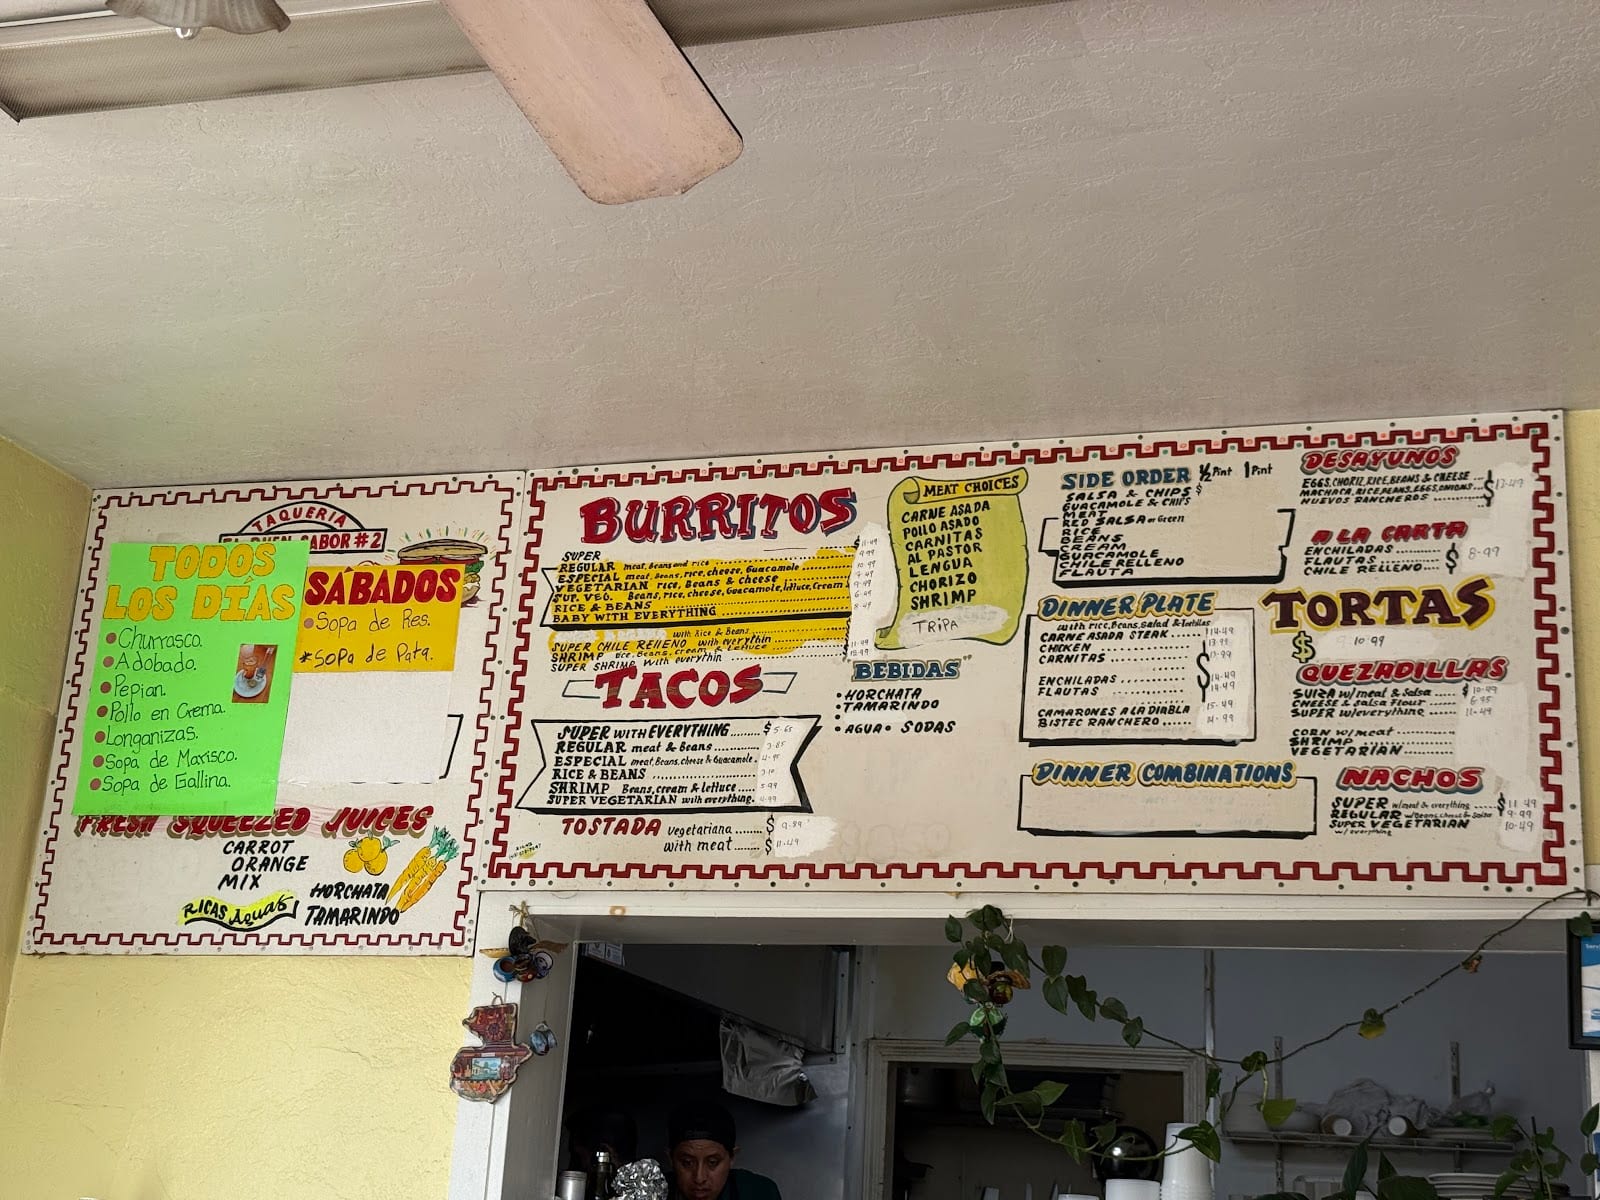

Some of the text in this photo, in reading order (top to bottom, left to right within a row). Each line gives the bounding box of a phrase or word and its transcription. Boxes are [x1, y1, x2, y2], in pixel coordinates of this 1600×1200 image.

[1301, 446, 1459, 474] DESAYUNOS
[922, 475, 1020, 498] MEAT CHOICES
[1061, 471, 1115, 490] SIDE
[1121, 467, 1192, 487] ORDER
[1066, 486, 1192, 502] SALSA CHIPS
[901, 500, 991, 524] CARNE ASADA
[1062, 499, 1145, 512] GUACAMOLE
[252, 506, 347, 532] TAQUERIA
[579, 487, 857, 543] BURRITOS
[1062, 510, 1108, 519] MEAT
[1062, 515, 1146, 528] RED SALSA
[940, 516, 980, 532] ASADO
[1062, 527, 1101, 537] RICE
[301, 532, 350, 550] ABOR
[905, 527, 984, 552] CARNITAS
[1060, 534, 1124, 544] BEANS
[1311, 521, 1469, 545] A LA CARTA
[907, 542, 983, 566] AL PASTOR
[1059, 549, 1159, 560] GUACAMOLE
[1060, 543, 1127, 552] CREAM
[1304, 545, 1394, 556] ENCHILADAS
[149, 543, 277, 581] TODOS
[561, 550, 601, 562] SUPER
[1059, 557, 1184, 569] CHILE RELLENO
[1304, 555, 1377, 566] FLAUTAS
[557, 563, 800, 584] ESPECIAL Guacamole
[558, 562, 615, 573] REGULAR
[909, 557, 973, 578] LENGUA
[1058, 568, 1134, 577] FLAUTA
[1303, 562, 1423, 576] CHILE RELLENO
[304, 566, 461, 606] SÁBADOS
[555, 581, 649, 593] VEGETARIAN
[738, 574, 779, 585] cheese
[909, 572, 977, 593] CHORIZO
[103, 576, 296, 622] LOS DÍAS
[554, 601, 652, 613] RICE BEANS
[910, 589, 977, 611] SHRIMP
[1039, 590, 1217, 619] DINNER PLATE
[1260, 577, 1493, 630] TORTAS
[315, 607, 431, 638] Sopa de Res.
[552, 606, 717, 623] BABY WITH EVERYTHING
[1057, 622, 1086, 631] with
[118, 626, 203, 650] Churrasco.
[1040, 629, 1169, 643] CARNE ASADA STEAK
[552, 638, 718, 652] SUPER CHILE with
[1291, 630, 1316, 663] $
[115, 652, 197, 673] Adobado.
[314, 643, 433, 668] Sopa de Pata.
[551, 652, 604, 662] SHRIMP
[1038, 652, 1106, 664] CARNITAS
[551, 658, 669, 672] SUPER with
[1298, 656, 1508, 684] QUEZADILLAS
[114, 674, 166, 702] Pepian.
[595, 664, 763, 709] TACOS
[1038, 674, 1117, 686] ENCHILADAS
[844, 687, 923, 701] HORCHATA
[1037, 686, 1099, 697] FLAUTAS
[1292, 688, 1336, 699] SUIZA
[843, 699, 940, 713] TAMARINDO
[1037, 705, 1191, 717] CAMARONES LA DIABLA
[1291, 699, 1339, 708] CHEESE
[110, 701, 226, 723] Pollo en Crema.
[1290, 708, 1336, 718] SUPER
[844, 720, 957, 734] AGUA SODAS
[1037, 716, 1160, 728] BISTEC RANCHERO
[106, 725, 199, 754] Longanizas.
[557, 723, 730, 741] SUPER WITH EVERYTHING
[1292, 728, 1331, 737] CORN
[554, 741, 713, 754] REGULAR meat Beans
[1289, 736, 1353, 746] SHRIMP
[1290, 745, 1403, 756] VEGETARIAN
[105, 748, 238, 774] Sopa de Marisco.
[553, 756, 627, 767] ESPECIAL
[551, 768, 646, 780] RICE BEANS
[1034, 761, 1295, 786] DINNER COMBINATIONS
[1338, 767, 1483, 793] NACHOS
[102, 770, 231, 796] Sopa de Gallina.
[548, 782, 610, 795] SHRIMP
[546, 795, 677, 805] SUPER VEGETARIAN
[1332, 796, 1389, 809] SUPER
[75, 806, 434, 838] FRESH SQUEEZED JUICES
[1330, 809, 1402, 819] REGULAR
[562, 817, 662, 836] TOSTADA
[1329, 819, 1470, 829] SUPER VEGETARIAN
[222, 840, 295, 855] CARROT
[663, 836, 733, 852] with meat
[231, 856, 309, 872] ORANGE
[217, 874, 262, 890] MIX
[310, 882, 390, 900] HORCHATA
[183, 899, 228, 920] RICAS
[305, 905, 400, 926] TAMARINDO
